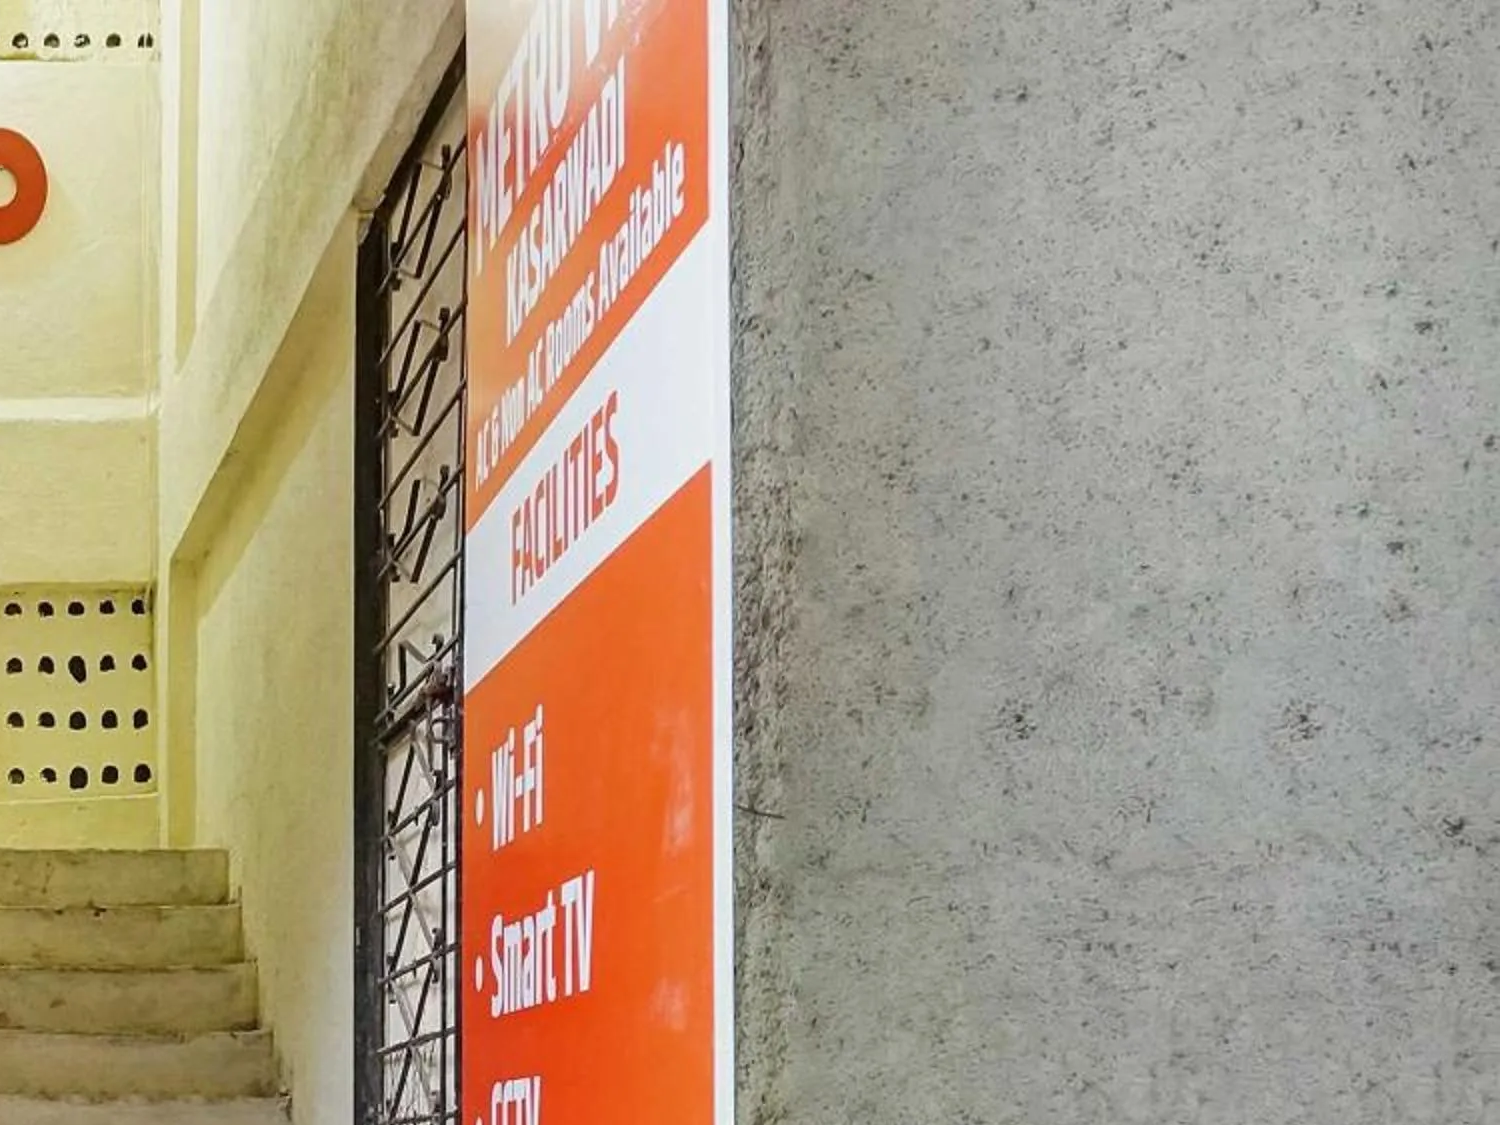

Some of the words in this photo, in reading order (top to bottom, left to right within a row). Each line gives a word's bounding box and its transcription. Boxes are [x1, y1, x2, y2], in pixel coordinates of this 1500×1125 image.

[506, 53, 626, 349] KASARWADI
[526, 336, 543, 421] AC
[598, 139, 685, 321] Available
[511, 390, 619, 606] FACILITIES
[491, 703, 544, 852] Wi-Fi
[491, 889, 556, 1019] Smart
[561, 869, 595, 997] TV
